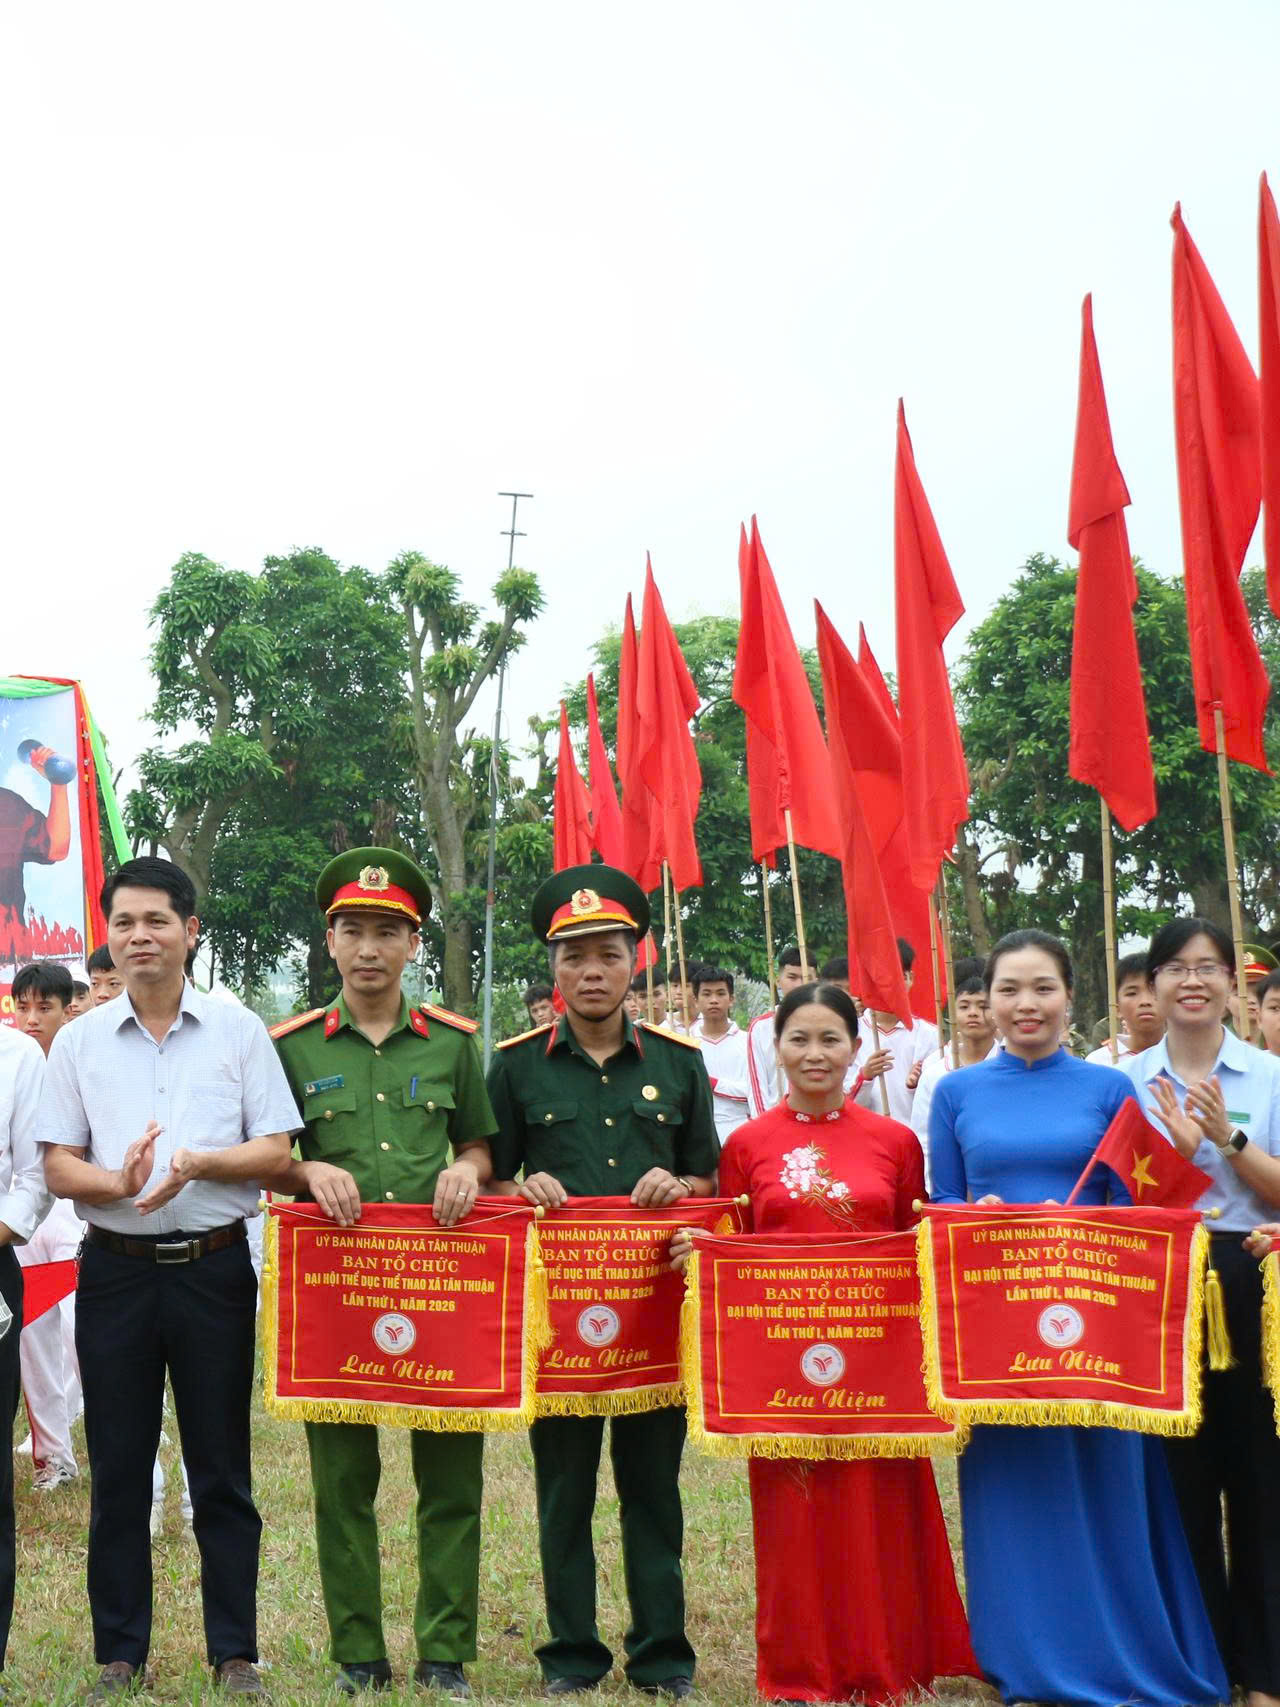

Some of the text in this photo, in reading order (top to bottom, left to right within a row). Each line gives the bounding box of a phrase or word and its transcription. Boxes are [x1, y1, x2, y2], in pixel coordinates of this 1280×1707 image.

[539, 1231, 555, 1240] AN
[558, 1229, 586, 1241] NHÂN
[589, 1229, 610, 1241] DÂN
[613, 1229, 627, 1241] XÃ
[630, 1229, 651, 1240] TÂN
[990, 1229, 1012, 1241] BAN
[1015, 1227, 1046, 1241] NHÂN
[1048, 1225, 1070, 1239] DÂN
[1072, 1228, 1086, 1241] XÃ
[1088, 1230, 1108, 1245] TÂN
[1110, 1234, 1147, 1252] THUẬN
[333, 1237, 354, 1248] BAN
[356, 1237, 385, 1250] NHÂN
[388, 1238, 410, 1251] DÂN
[412, 1239, 426, 1252] XÃ
[428, 1240, 448, 1253] TÂN
[450, 1241, 486, 1256] THUẬN
[544, 1243, 659, 1261] BAN TỔ CHỨC
[1002, 1241, 1117, 1267] BAN TỔ CHỨC
[342, 1252, 459, 1272] BAN TỔ CHỨC
[564, 1268, 583, 1282] DỤC
[585, 1264, 603, 1279] THỂ
[605, 1268, 630, 1279] THAO
[632, 1266, 643, 1279] XÃ
[754, 1268, 776, 1279] BAN
[779, 1267, 808, 1279] NHÂN
[811, 1266, 833, 1279] DÂN
[835, 1267, 848, 1279] XÃ
[852, 1265, 872, 1279] TÂN
[875, 1265, 911, 1280] THUẬN
[305, 1271, 495, 1294] ĐẠI HỘI THỂ DỤC THỂ THAO XÃ TÂN THUẬN
[765, 1281, 885, 1300] BAN TỔ CHỨC
[343, 1291, 455, 1312] LẦN THỨ I, NĂM 2026
[570, 1287, 593, 1299] THỨ
[594, 1289, 601, 1301] I,
[605, 1287, 630, 1299] NĂM
[1006, 1285, 1028, 1302] LẦN
[1030, 1284, 1052, 1299] THỨ
[1053, 1287, 1061, 1299] I,
[1064, 1287, 1091, 1300] NĂM
[727, 1305, 744, 1320] ĐẠI
[746, 1304, 763, 1320] HỘI
[765, 1302, 783, 1318] THỂ
[786, 1306, 805, 1320] DỤC
[808, 1302, 825, 1318] THỂ
[828, 1306, 852, 1318] THAO
[855, 1304, 867, 1318] XÃ
[870, 1304, 888, 1317] TÂN
[767, 1324, 884, 1339] LẦN THỨ I, NĂM 2026
[544, 1348, 649, 1368] Lưu Niệm
[1008, 1350, 1120, 1375] Lưu Niệm
[340, 1355, 455, 1384] Lưu Niệm
[767, 1388, 886, 1412] Lưu Niệm
